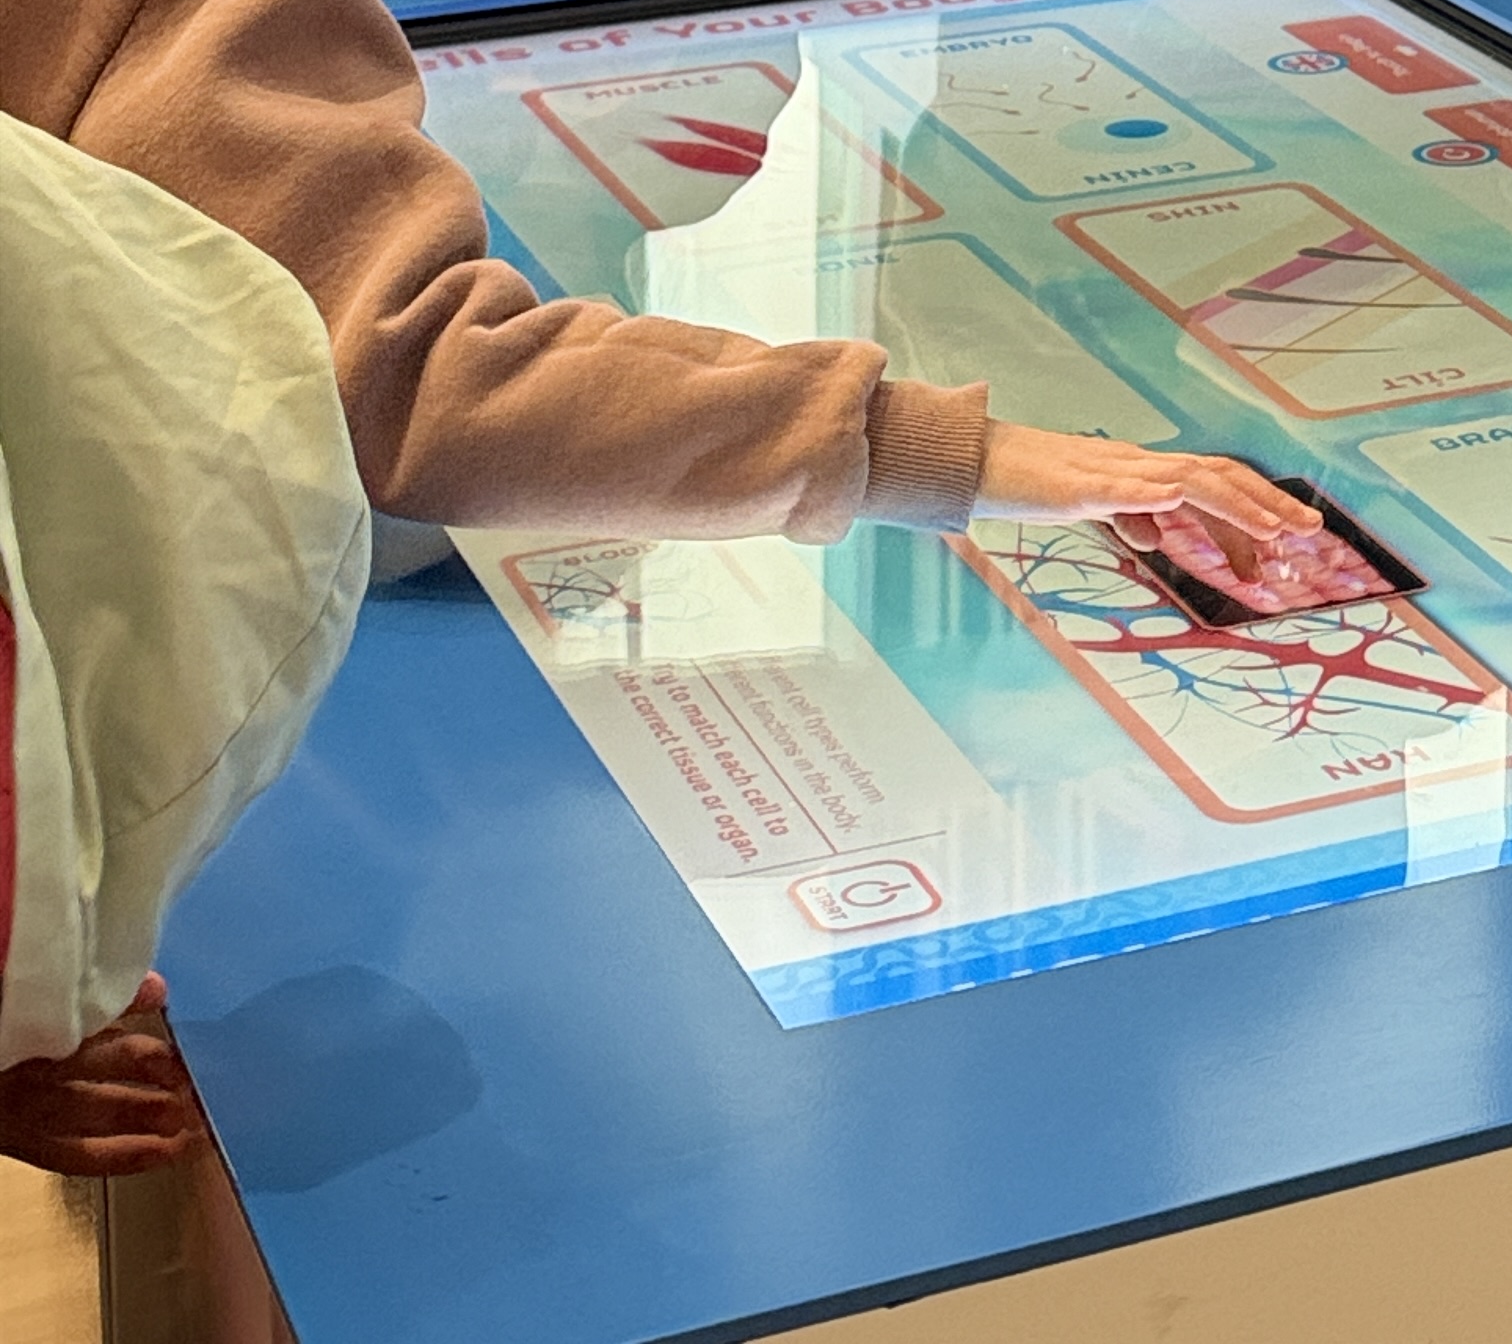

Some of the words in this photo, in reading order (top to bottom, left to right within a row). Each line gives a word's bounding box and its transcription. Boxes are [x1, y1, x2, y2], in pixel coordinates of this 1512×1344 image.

[559, 28, 631, 53] of
[654, 9, 818, 39] Your
[900, 34, 1033, 58] EMBRYO
[585, 74, 723, 100] MUSCLE
[1382, 367, 1466, 391] CİLT
[612, 669, 642, 693] the
[630, 695, 682, 745] correct
[667, 746, 712, 793] tissue
[701, 795, 727, 811] or
[714, 814, 759, 863] organ.
[667, 685, 691, 703] to
[680, 704, 730, 750] match
[714, 751, 759, 787] each
[741, 788, 782, 816] cell
[763, 817, 789, 836] to
[808, 884, 849, 924] START
